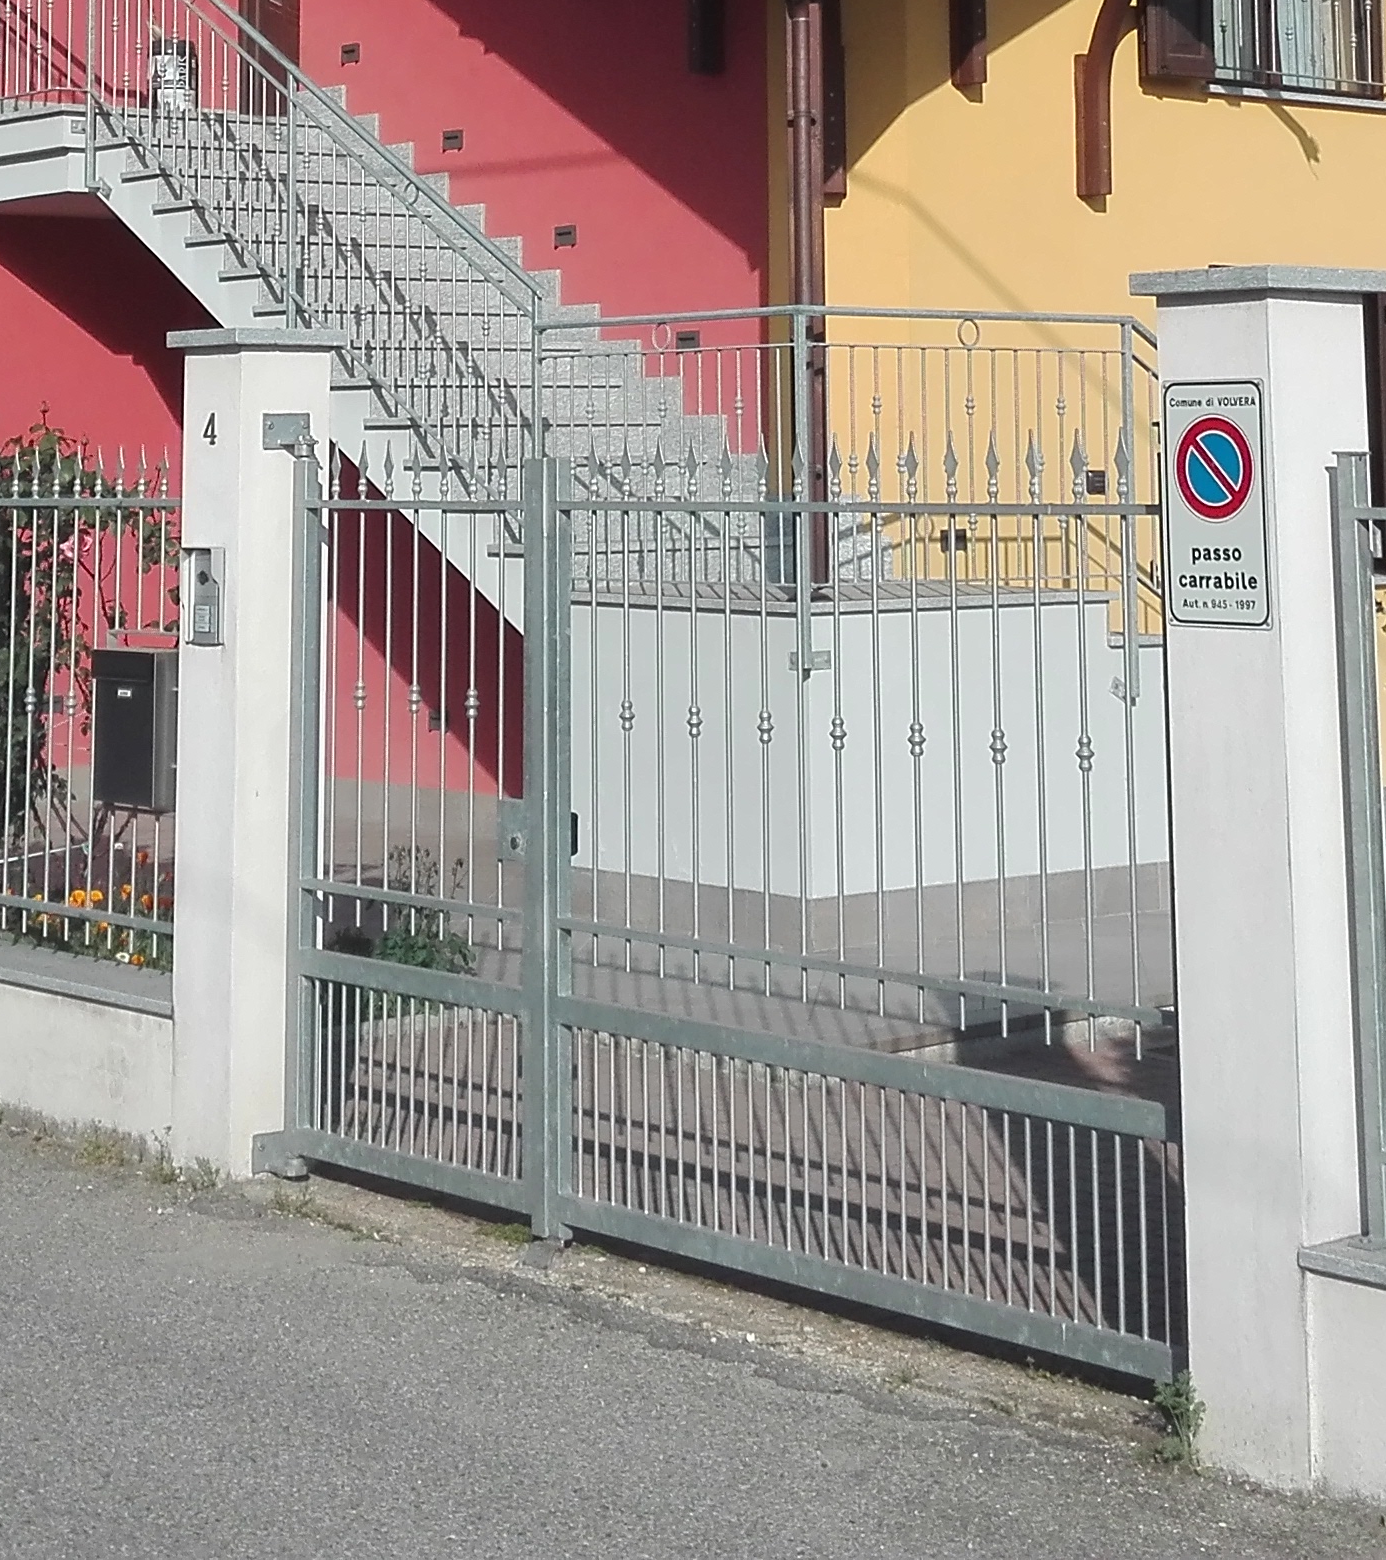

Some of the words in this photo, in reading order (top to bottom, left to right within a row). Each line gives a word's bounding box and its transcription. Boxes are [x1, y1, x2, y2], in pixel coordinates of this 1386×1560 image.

[1169, 397, 1202, 407] Comune
[1205, 397, 1214, 407] di
[1217, 396, 1256, 406] VOLVERA
[203, 412, 217, 445] 4
[1191, 547, 1242, 565] passo
[1179, 571, 1258, 590] carrabile
[1235, 600, 1256, 610] 1997
